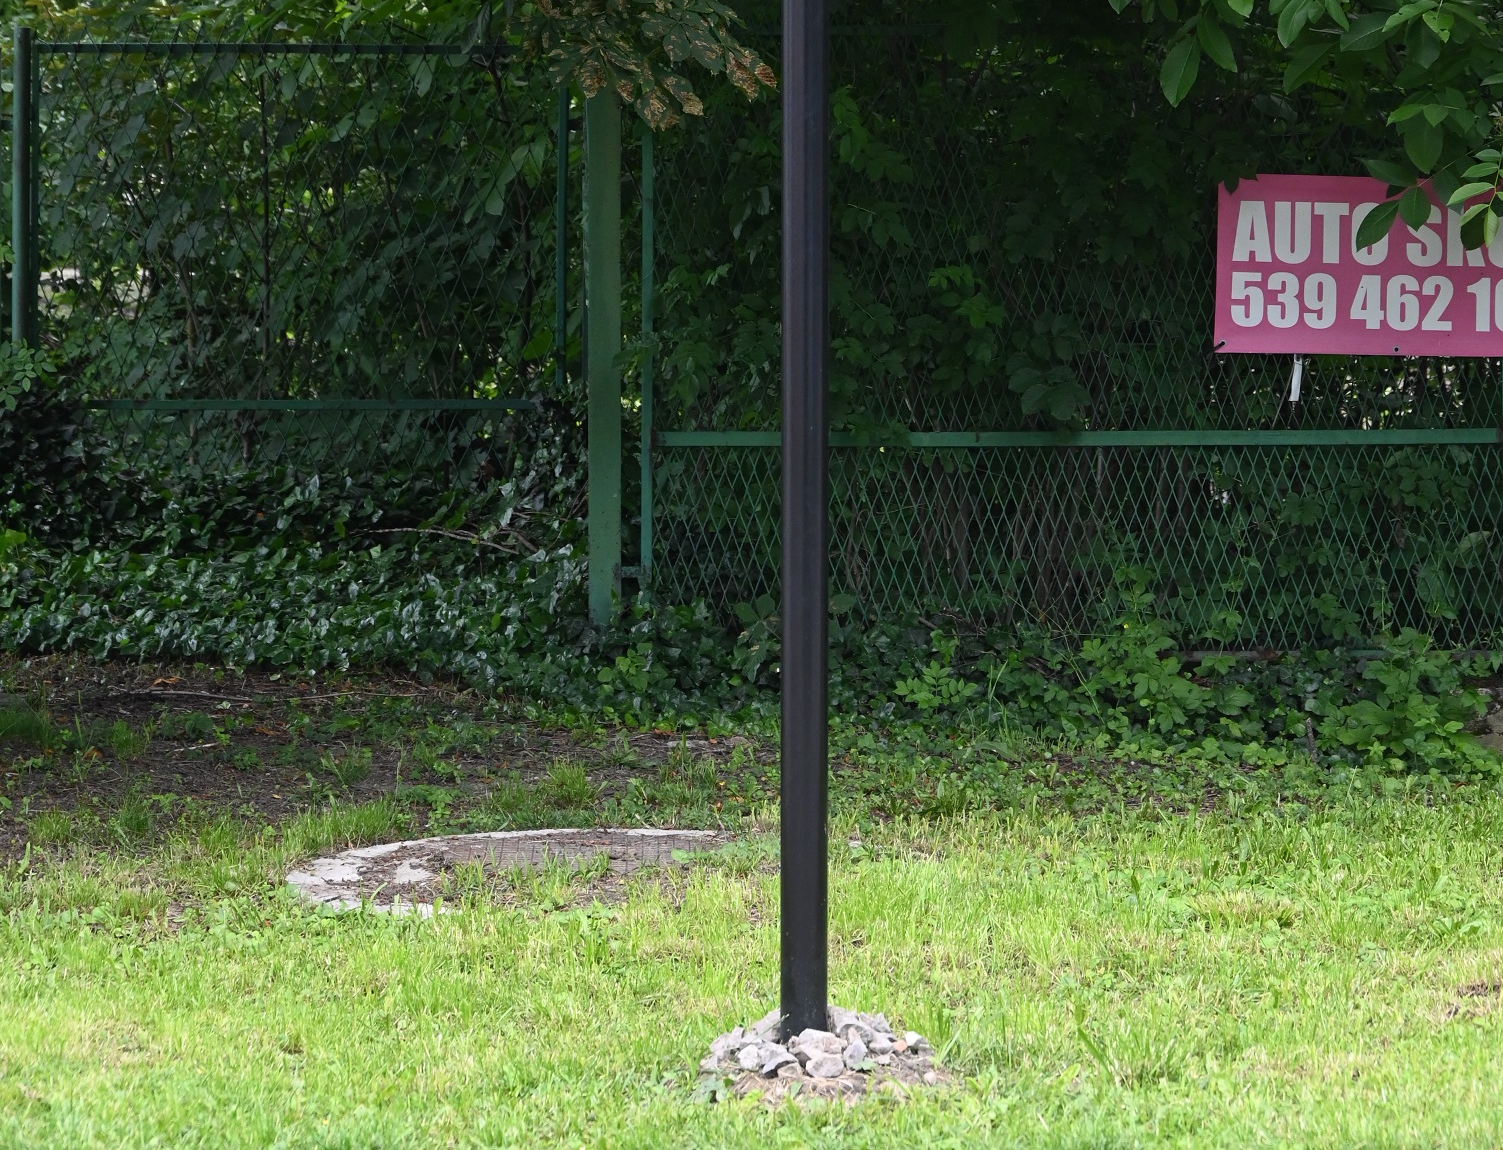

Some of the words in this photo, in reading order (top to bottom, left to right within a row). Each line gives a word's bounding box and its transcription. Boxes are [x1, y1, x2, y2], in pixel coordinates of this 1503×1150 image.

[1232, 200, 1389, 266] AUTO
[1230, 271, 1337, 330] 539
[1350, 274, 1455, 332] 462
